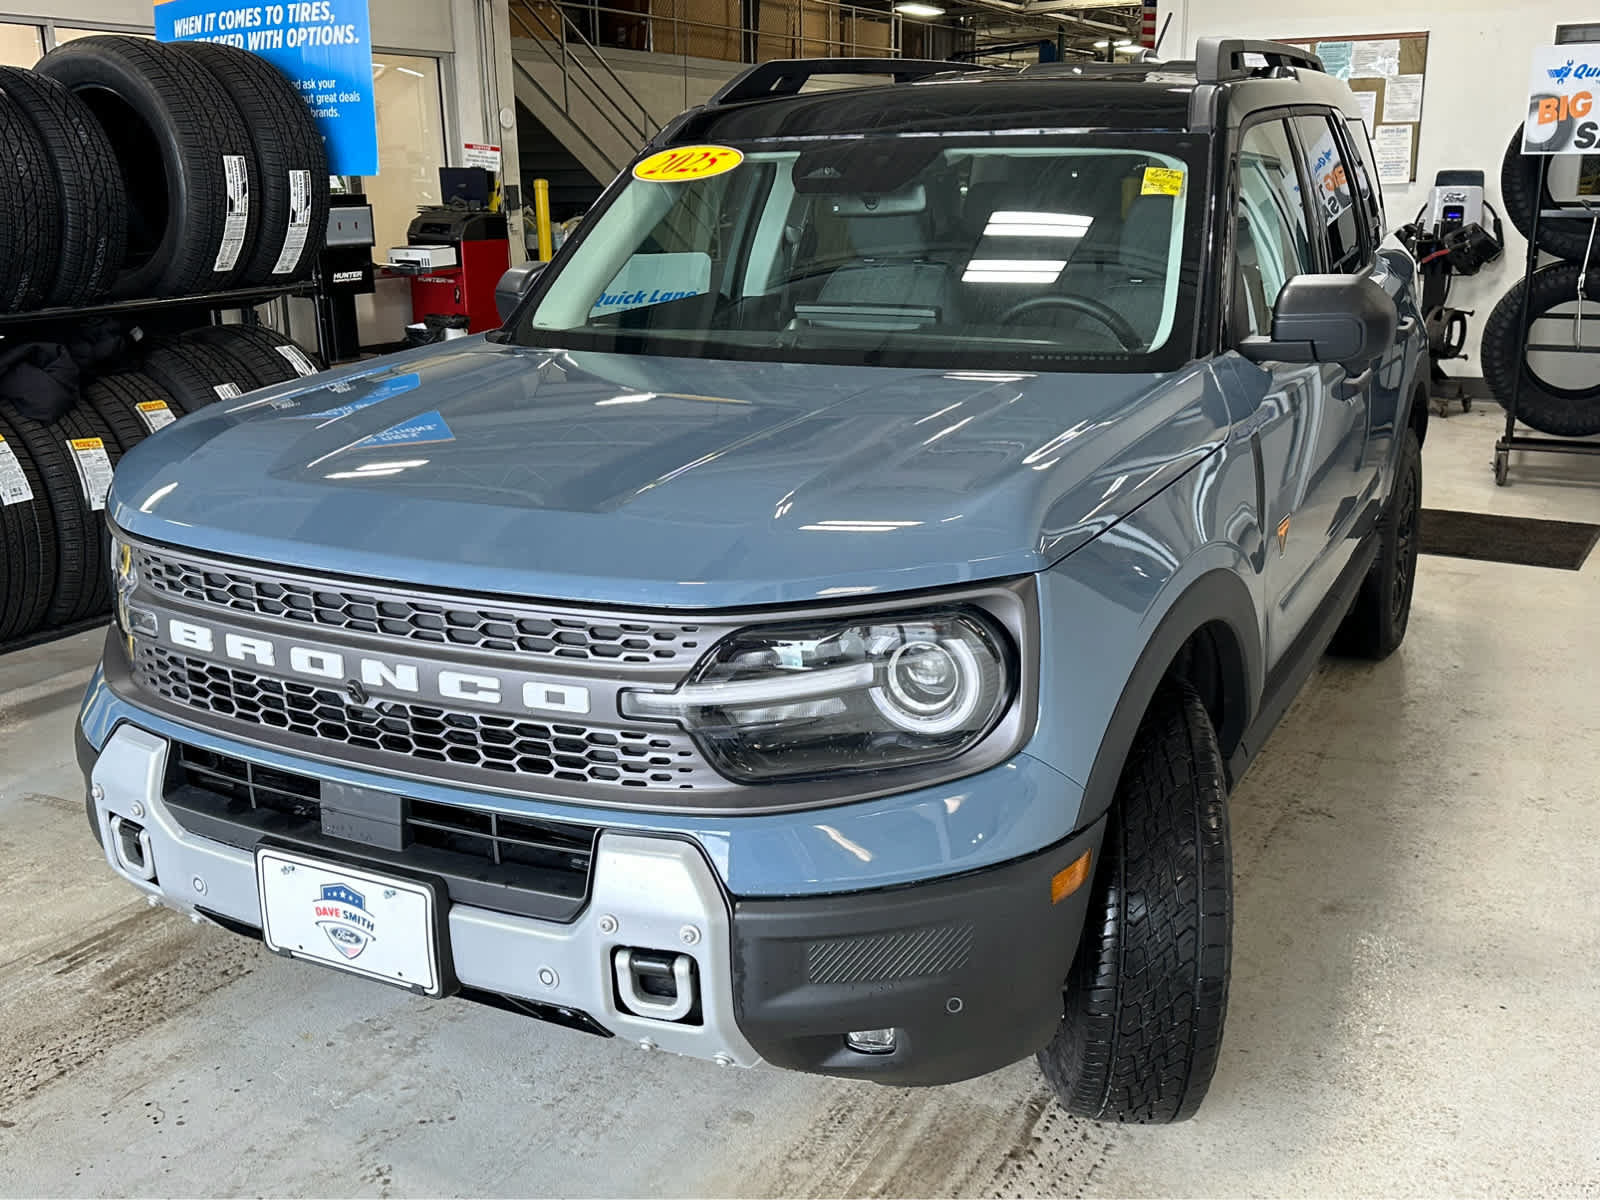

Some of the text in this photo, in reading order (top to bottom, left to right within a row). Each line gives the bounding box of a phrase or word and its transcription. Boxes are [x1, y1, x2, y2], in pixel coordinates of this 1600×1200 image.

[174, 1, 336, 38] WHEN IT COMES TO TIRES,
[247, 29, 284, 51] WITH
[286, 24, 360, 49] OPTIONS.
[302, 78, 317, 89] ask
[317, 79, 337, 91] your
[316, 92, 338, 105] great
[338, 90, 361, 103] deals
[1537, 91, 1593, 126] BIG
[310, 106, 341, 118] brands.
[643, 151, 731, 175] 2025
[333, 271, 363, 280] HUNTER
[594, 290, 648, 308] Quick
[169, 618, 591, 715] BRONCO
[315, 906, 375, 932] DAVE SMITH
